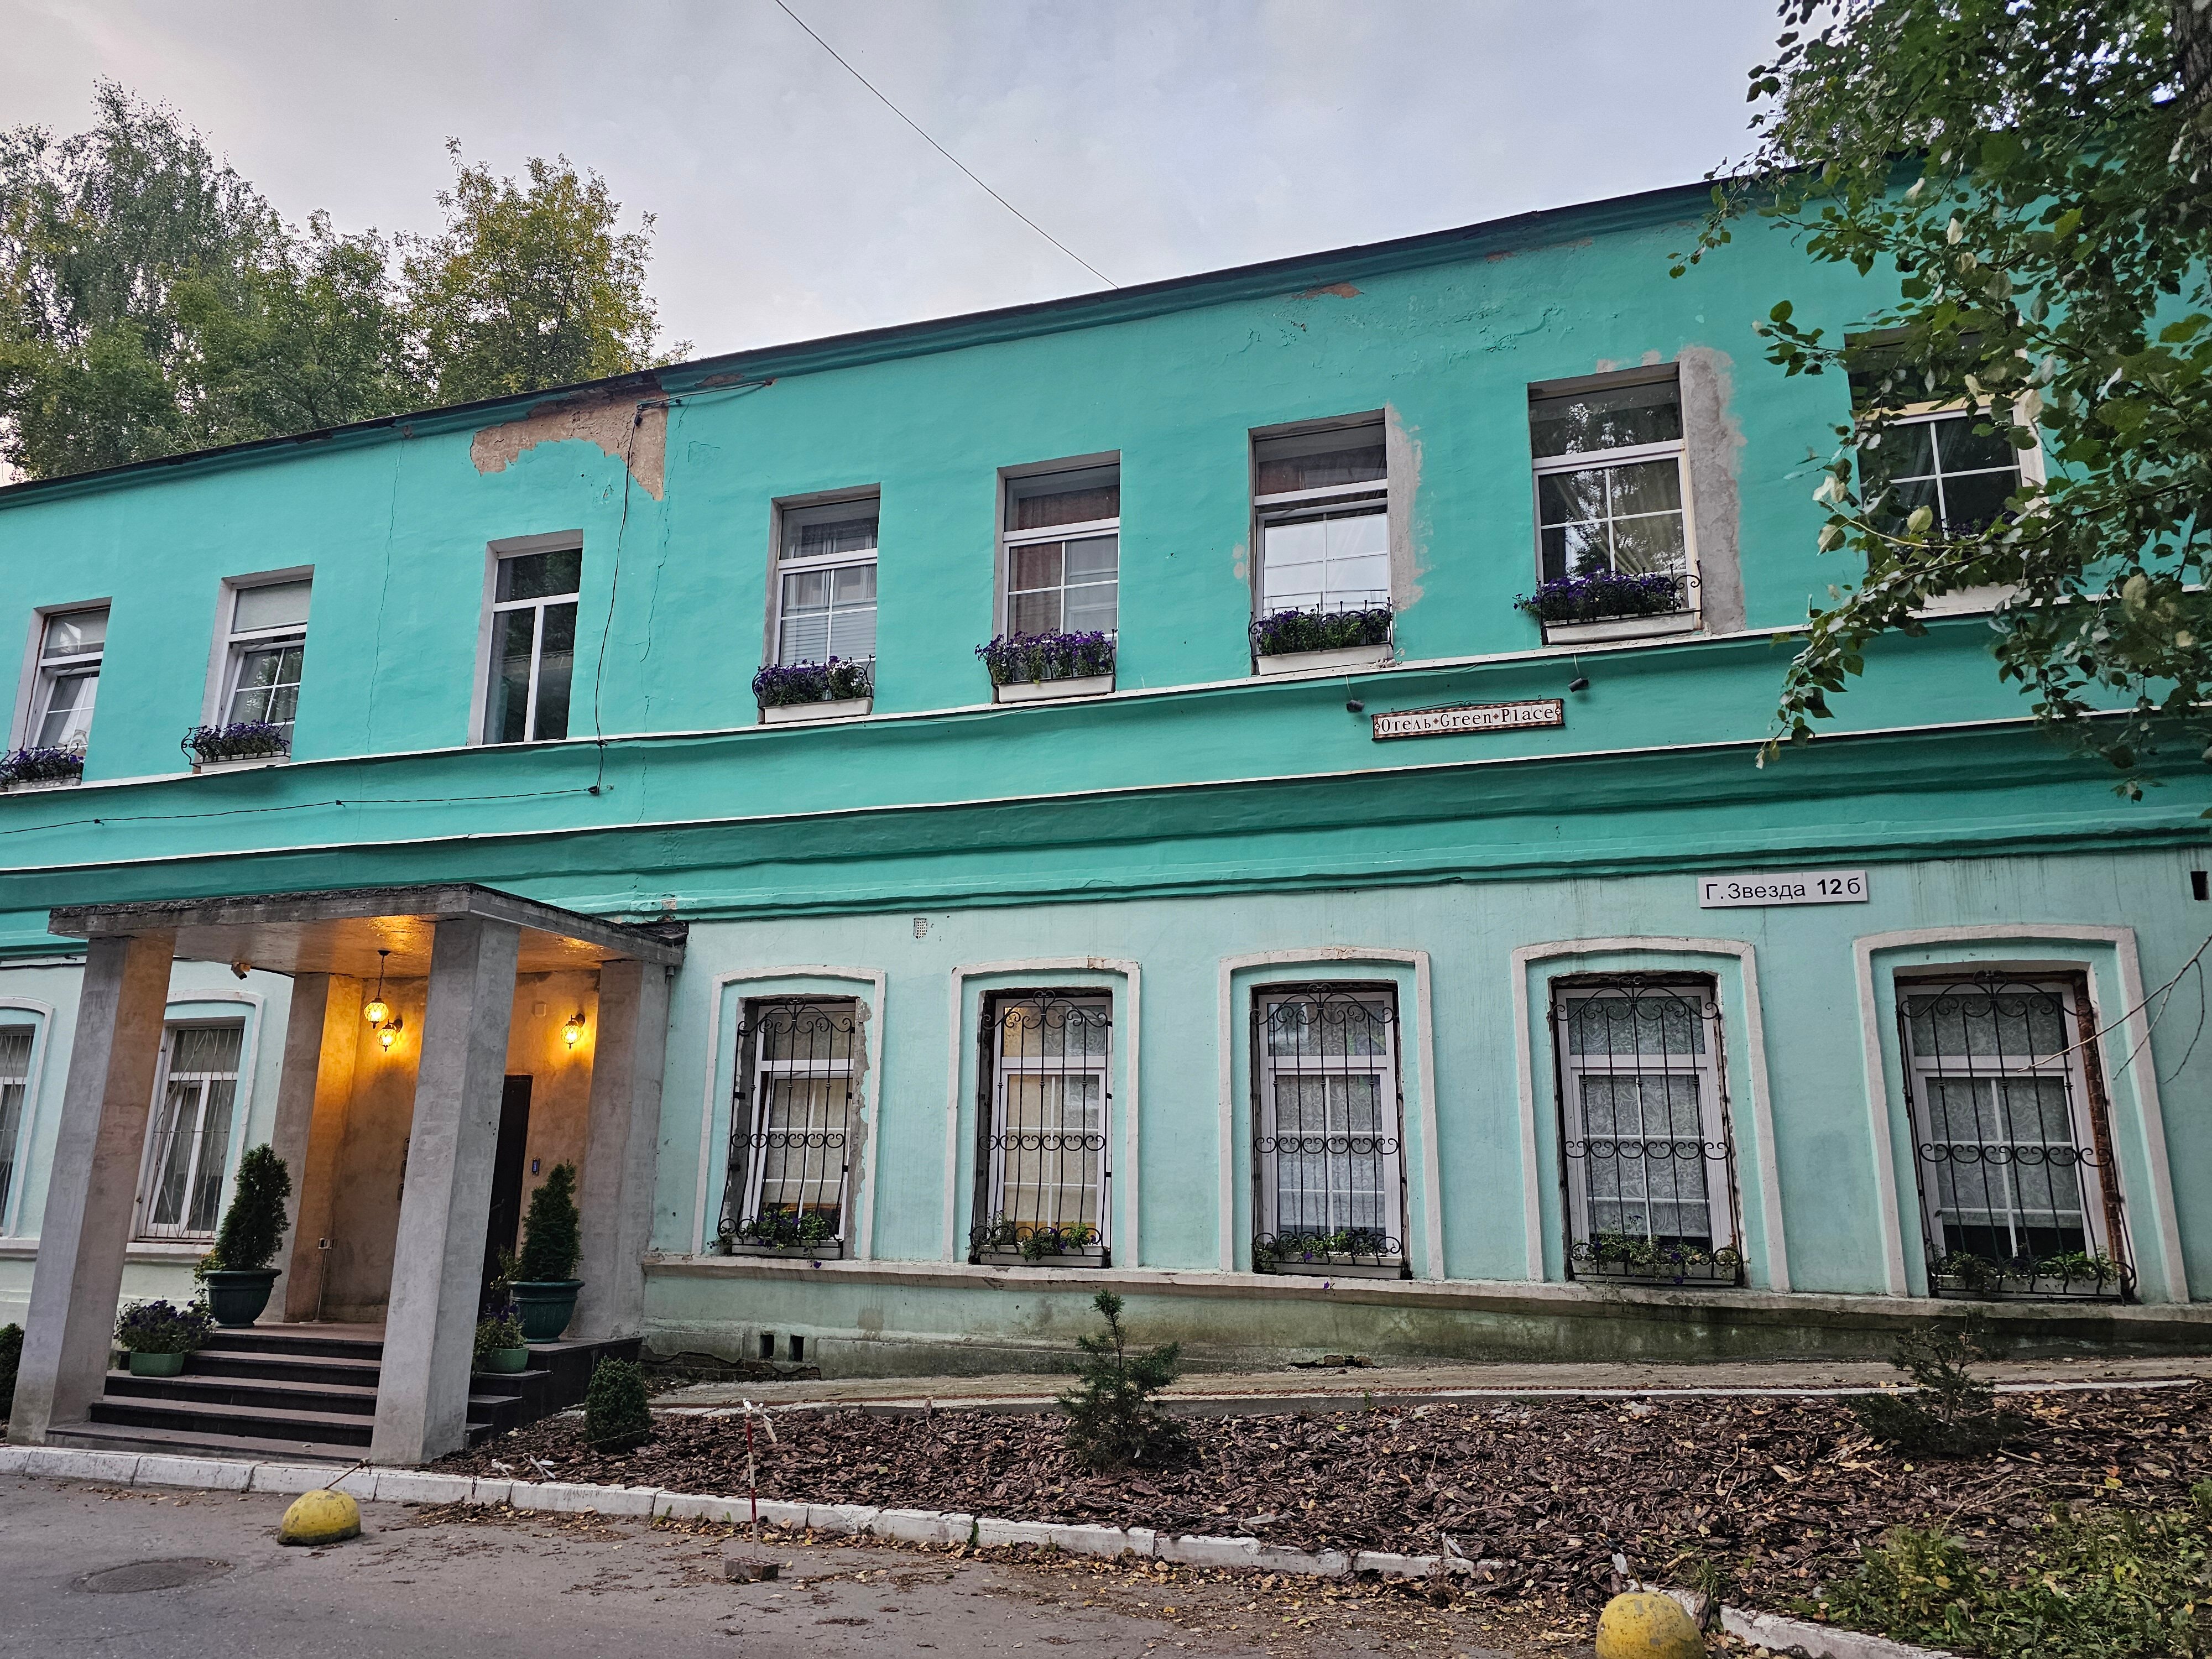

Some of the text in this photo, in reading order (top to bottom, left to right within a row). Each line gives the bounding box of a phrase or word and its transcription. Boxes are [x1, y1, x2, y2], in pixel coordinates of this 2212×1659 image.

[1381, 707, 1553, 733] Отель Green Place
